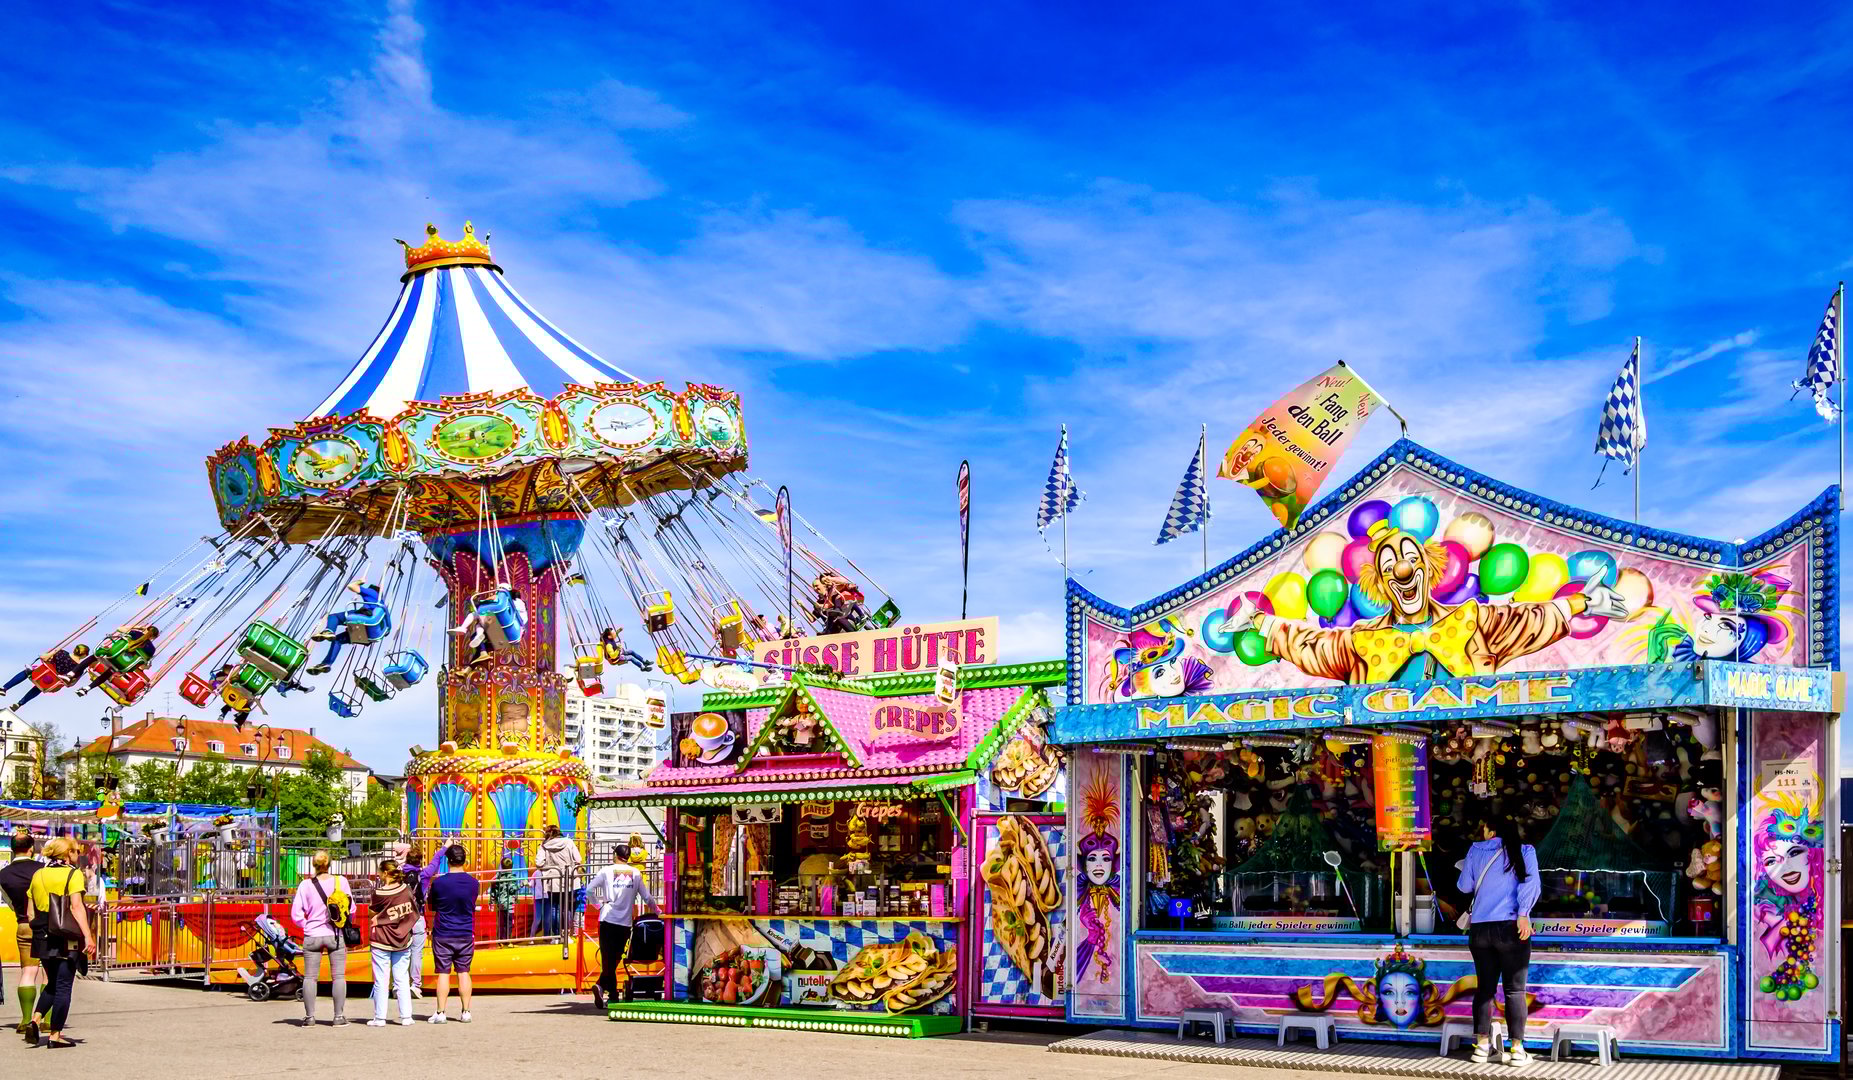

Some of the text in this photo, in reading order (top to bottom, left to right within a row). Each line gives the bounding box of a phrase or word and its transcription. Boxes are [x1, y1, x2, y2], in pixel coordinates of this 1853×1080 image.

[1317, 376, 1353, 389] Neu!
[1319, 393, 1348, 422] Fang
[1357, 393, 1370, 420] Neu!
[1288, 405, 1344, 446] den Ball
[1261, 417, 1328, 471] Jeder gewinnt!
[874, 627, 985, 672] HÜTTE
[1727, 670, 1813, 702] MAGIC GAME
[1137, 677, 1574, 730] MAGIC GAME
[875, 705, 957, 735] CREPES
[1410, 739, 1425, 750] Ball
[1777, 778, 1797, 787] 111
[803, 804, 832, 815] KAFFEE
[386, 902, 414, 921] STR
[1248, 920, 1273, 931] jeder
[1275, 920, 1313, 931] Spieler
[1315, 921, 1355, 931] gewinnt!
[1540, 923, 1571, 933] jeder
[1574, 923, 1617, 934] Spieler
[1620, 925, 1660, 935] gewinnt!
[797, 975, 831, 988] nutella
